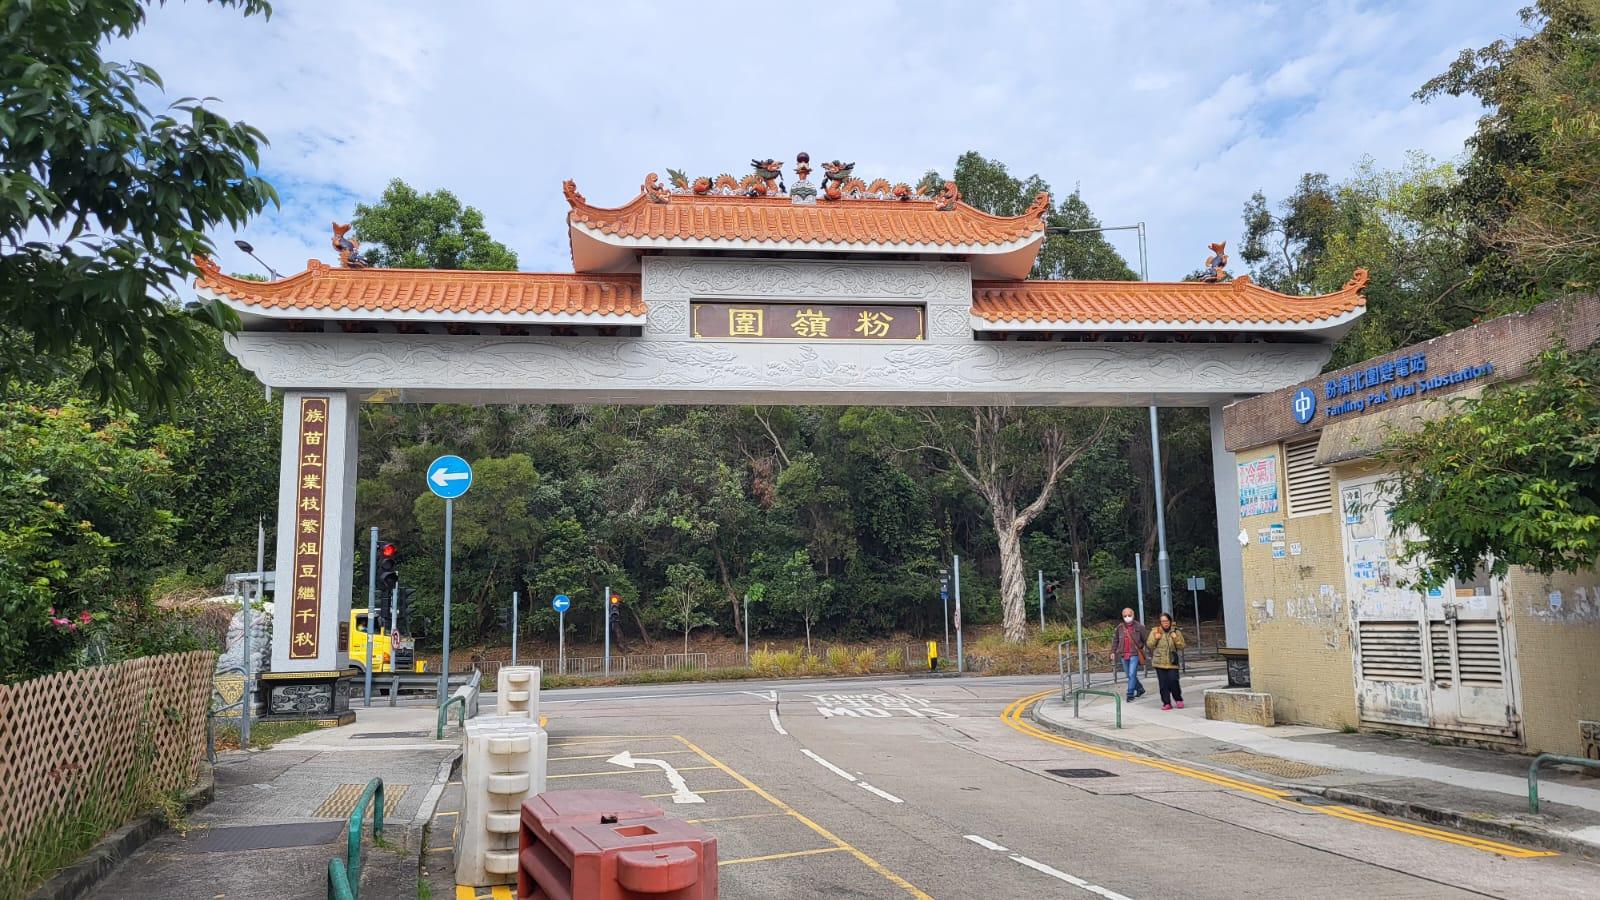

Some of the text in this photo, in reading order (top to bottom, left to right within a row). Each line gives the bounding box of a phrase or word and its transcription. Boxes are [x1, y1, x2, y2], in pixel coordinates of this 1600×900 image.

[1325, 352, 1427, 399] 粉嶺北圍變電站
[1326, 362, 1495, 417] Fanling Pak Wai Substation
[816, 706, 960, 718] SLOW
